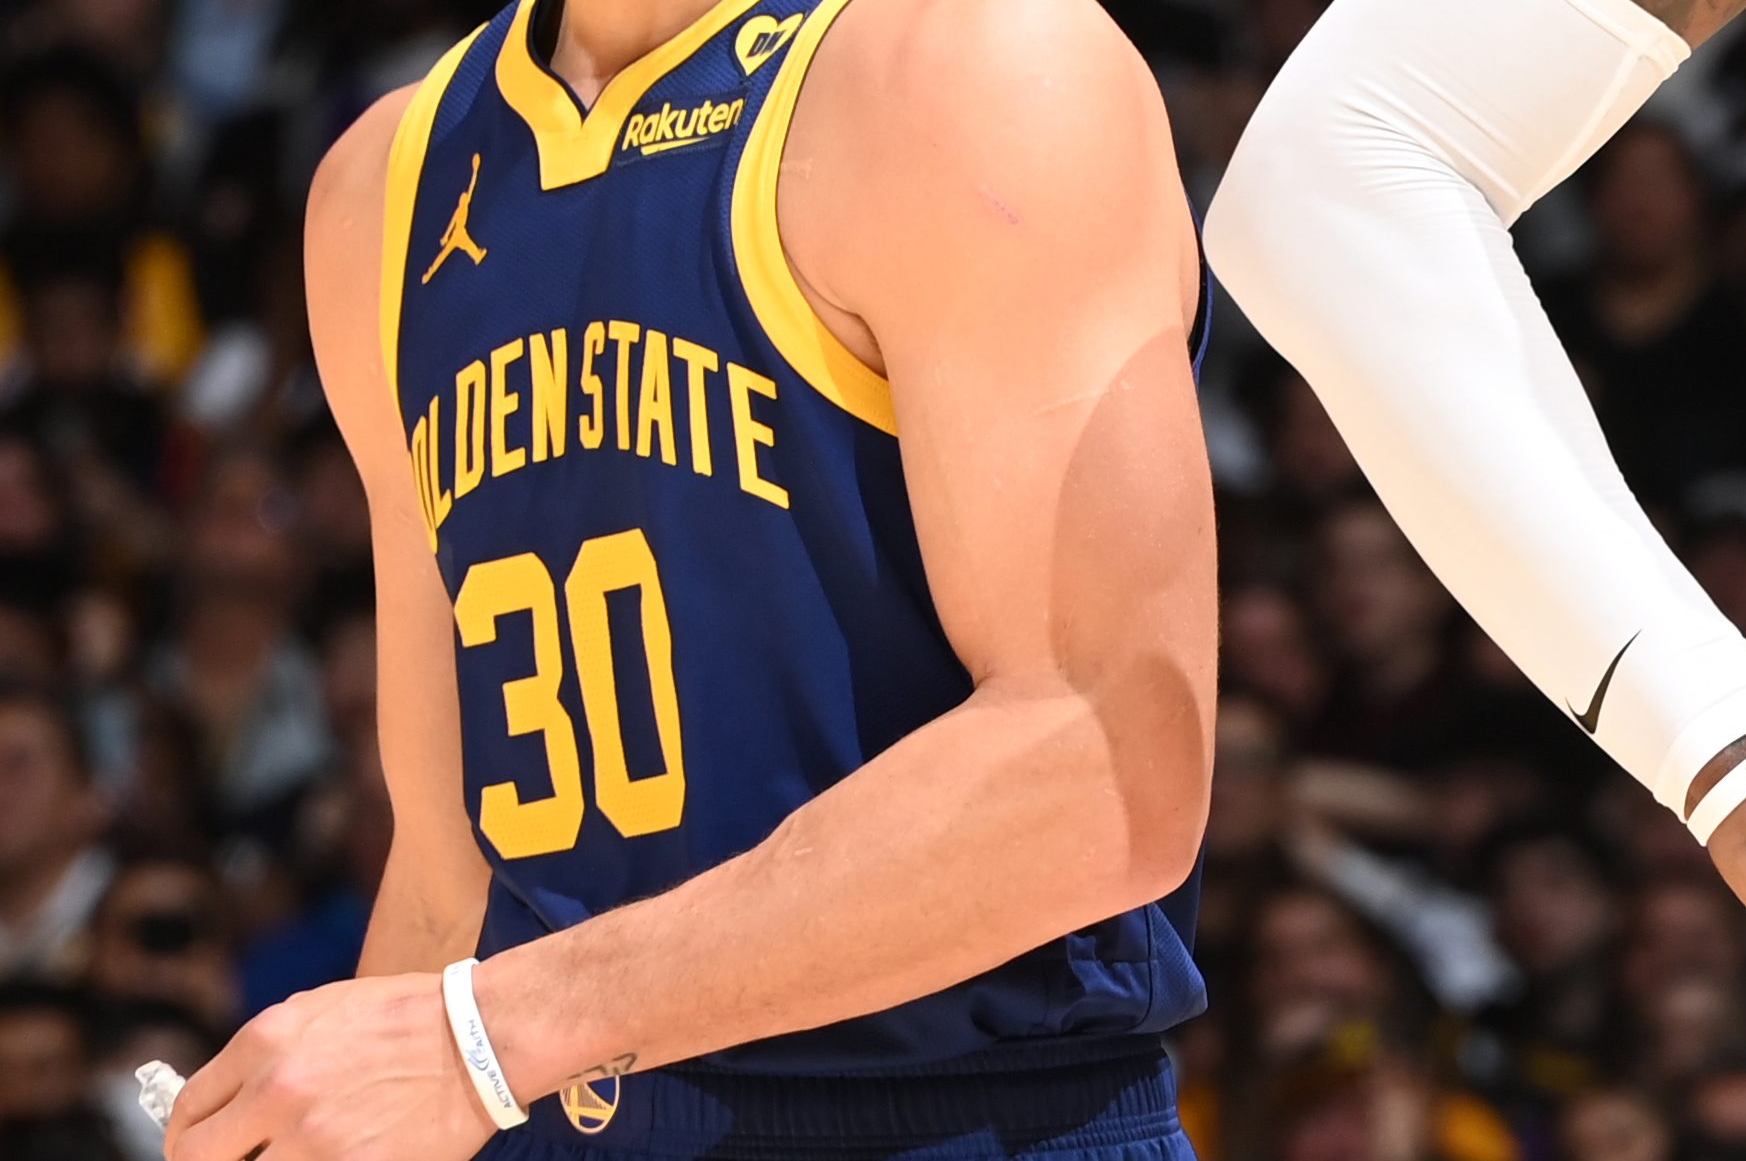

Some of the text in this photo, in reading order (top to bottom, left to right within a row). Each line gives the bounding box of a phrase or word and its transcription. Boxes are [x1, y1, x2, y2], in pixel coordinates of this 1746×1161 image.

[621, 98, 746, 152] Rakuten
[411, 319, 790, 555] OLDEN STATE
[453, 527, 686, 860] 30
